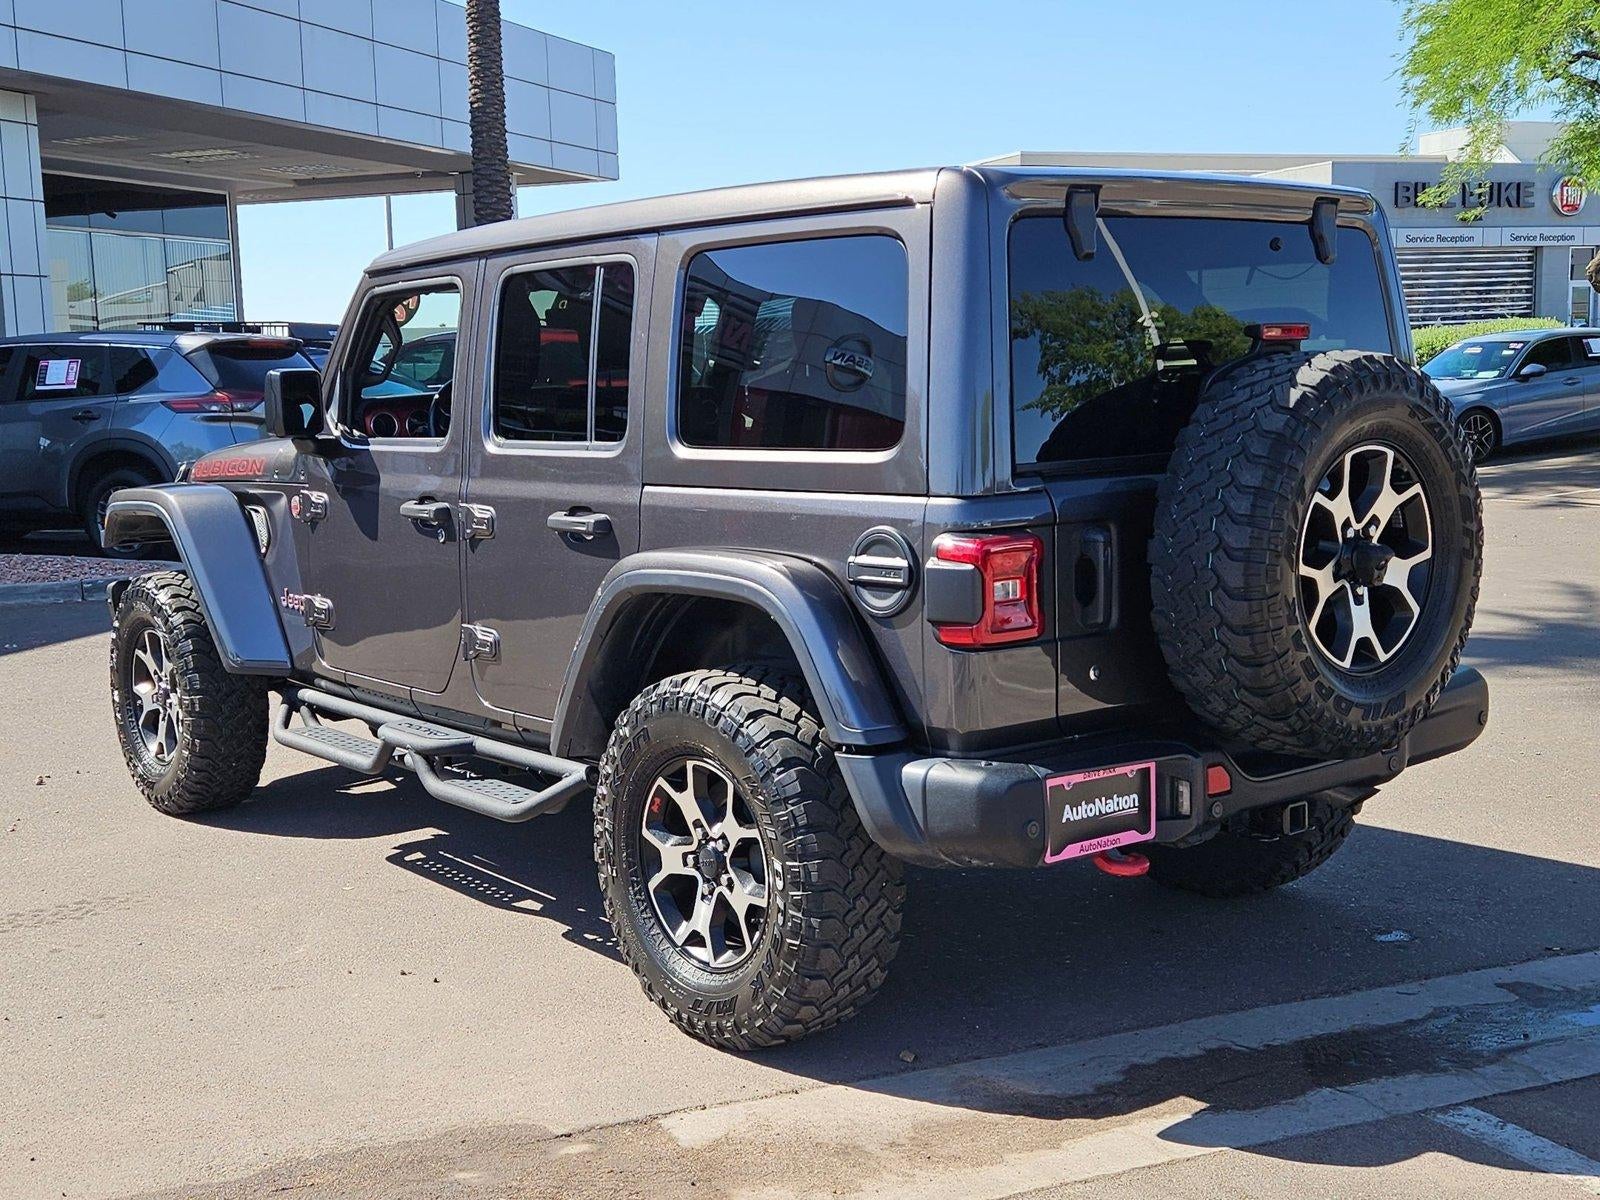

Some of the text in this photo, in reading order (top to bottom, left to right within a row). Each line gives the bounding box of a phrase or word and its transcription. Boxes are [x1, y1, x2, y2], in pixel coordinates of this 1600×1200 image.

[1394, 181, 1456, 208] BI
[1405, 233, 1475, 244] Service Reception
[1509, 232, 1576, 243] Service Reception
[189, 456, 266, 479] RUBICON
[280, 587, 306, 616] Jeep
[1062, 793, 1139, 823] AutoNation
[1078, 836, 1121, 854] AutoNation
